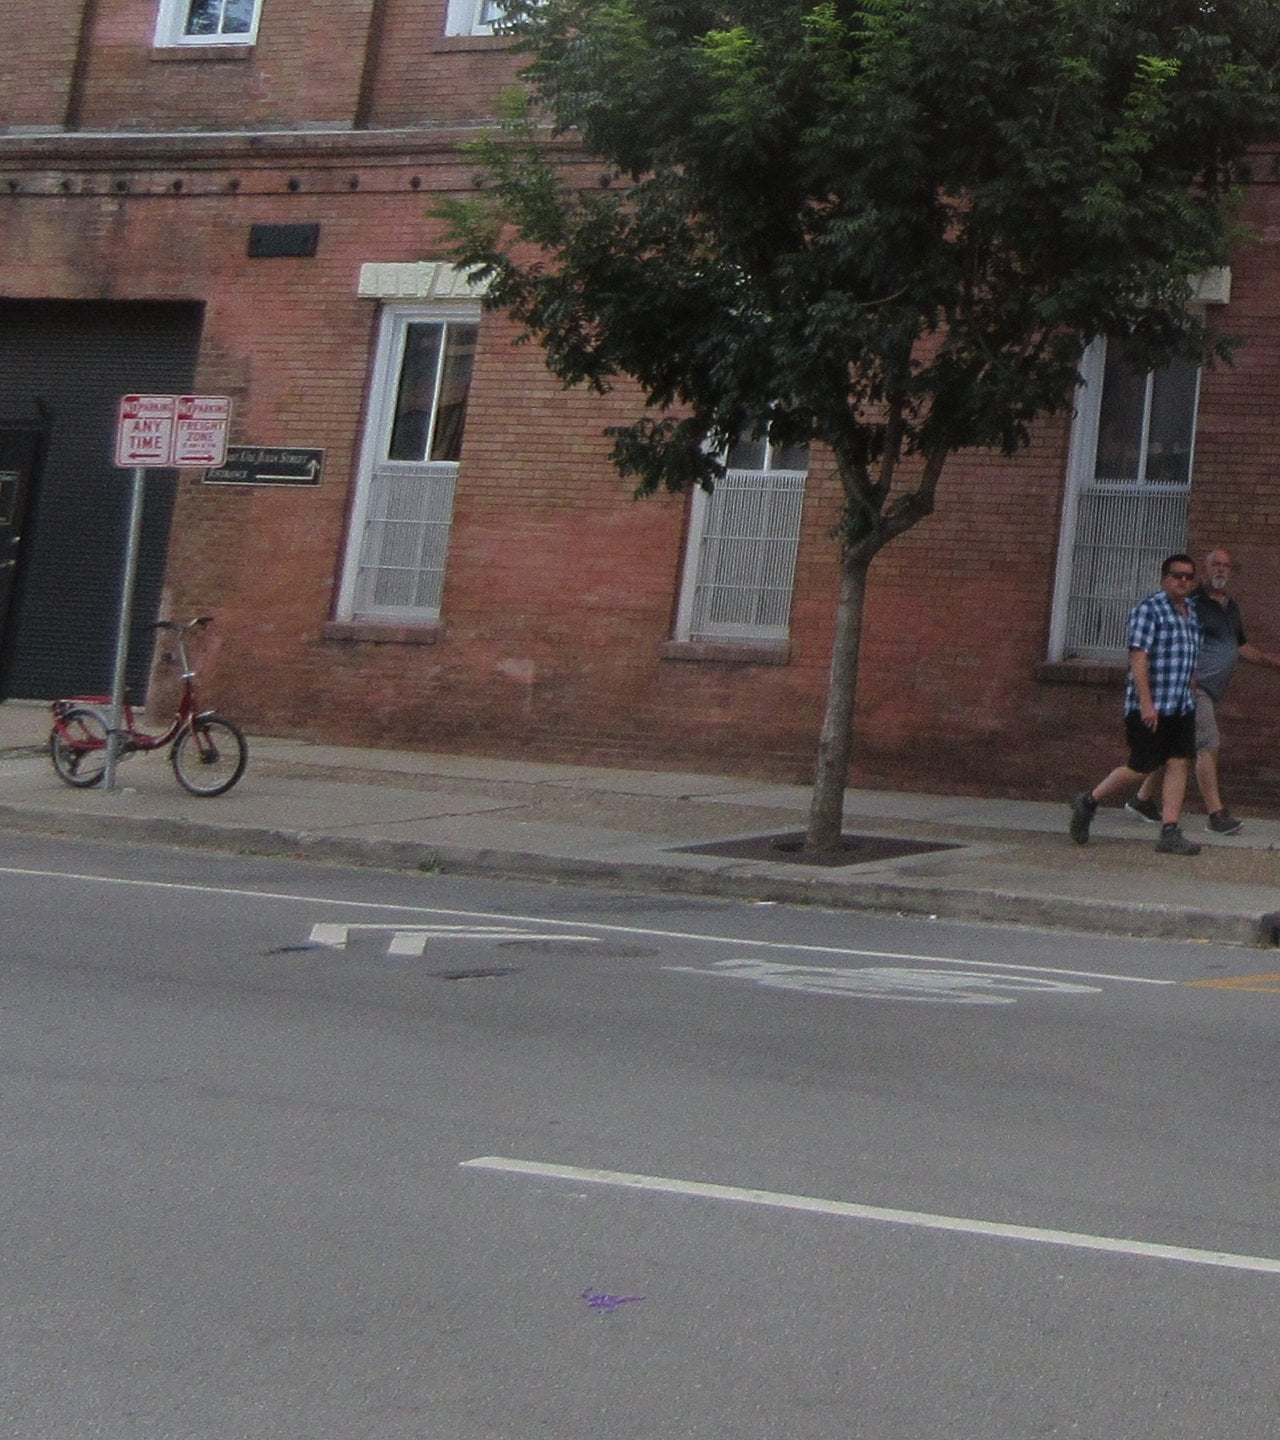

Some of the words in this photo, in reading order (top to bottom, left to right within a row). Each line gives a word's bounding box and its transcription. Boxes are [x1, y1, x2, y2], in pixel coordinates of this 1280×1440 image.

[133, 421, 161, 433] ANY
[180, 421, 224, 431] FREIGHT
[129, 436, 163, 449] TIME
[186, 432, 214, 442] ZONE
